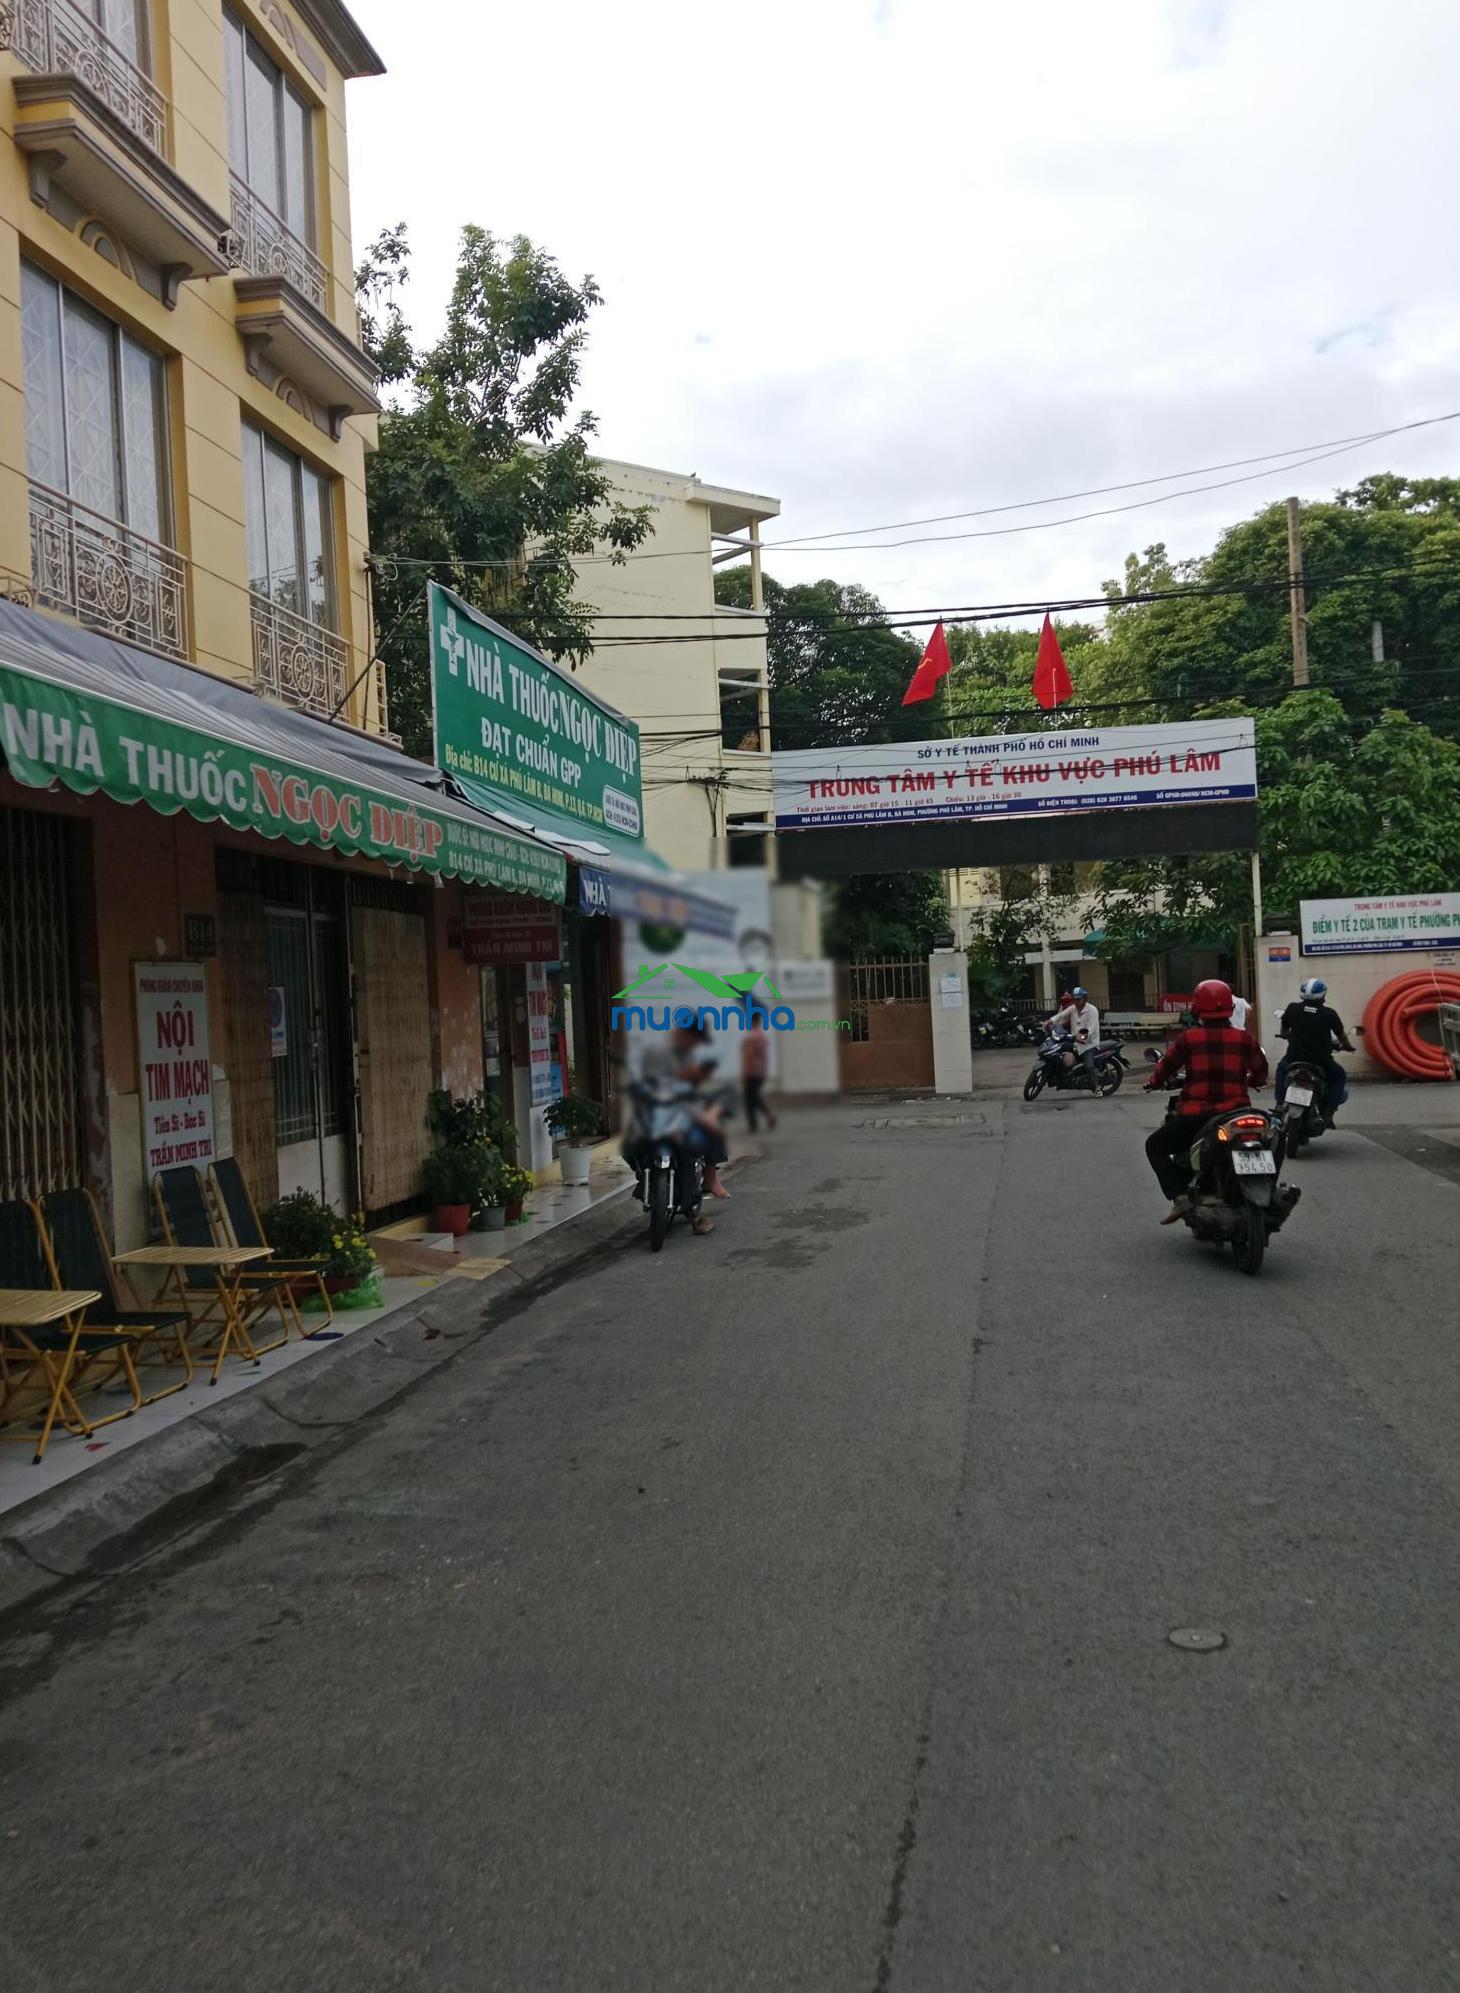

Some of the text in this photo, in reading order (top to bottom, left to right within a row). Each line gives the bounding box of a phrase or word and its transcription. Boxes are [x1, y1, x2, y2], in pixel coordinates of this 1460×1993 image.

[466, 638, 504, 704] NHÀ
[509, 664, 559, 734] THUỐC
[559, 690, 601, 764] NGỌC
[481, 717, 581, 788] ĐẠT CHUẨN GPP
[918, 745, 932, 759] SỞ
[935, 748, 943, 758] Y
[946, 742, 960, 756] TẾ
[1003, 737, 1027, 753] PHỐ
[1029, 737, 1045, 751] HỒ
[1048, 736, 1067, 749] CHÍ
[1070, 736, 1100, 748] MINH
[4, 702, 105, 778] NHÀ
[119, 736, 248, 812] THUỐC
[250, 762, 363, 842] NGỌC
[809, 748, 1221, 799] TRUNG TÂM Y TẾ KHU VỰC PHÚ LÂM
[584, 876, 607, 907] NHÀ
[1312, 914, 1332, 934] ĐIỂM
[1334, 919, 1339, 932] Y
[1340, 914, 1351, 932] TẾ
[1353, 919, 1358, 931] 2
[1360, 914, 1374, 931] CỦA
[1376, 916, 1399, 934] TRẠM
[1400, 916, 1406, 929] Y
[1407, 910, 1418, 929] TẾ
[1420, 910, 1450, 928] PHƯỜNG
[156, 1000, 194, 1055] NỘI
[145, 1059, 209, 1104] TIM MẠCH
[150, 1140, 174, 1167] TRẦN
[175, 1142, 198, 1162] MINH
